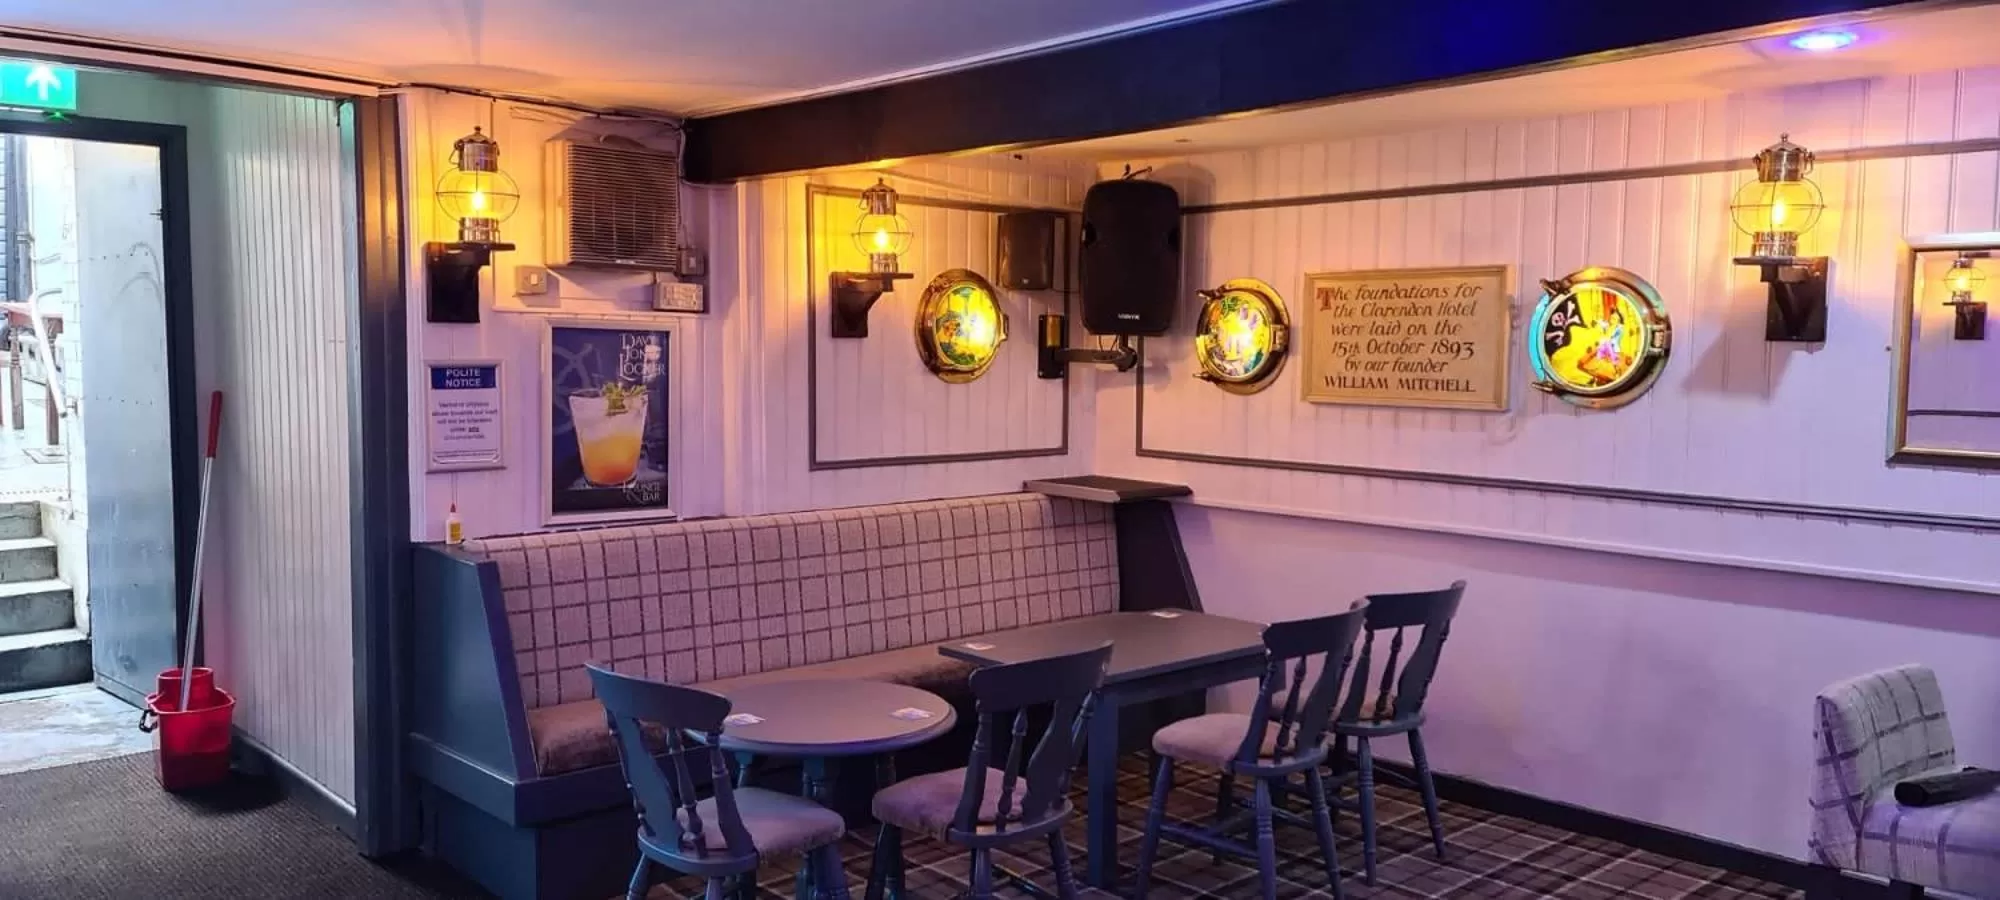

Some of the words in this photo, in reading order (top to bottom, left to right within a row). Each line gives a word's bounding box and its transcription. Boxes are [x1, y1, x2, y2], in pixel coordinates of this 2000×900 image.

[1316, 287, 1350, 311] The
[1354, 283, 1449, 301] foundations
[1453, 282, 1483, 299] for
[1333, 303, 1356, 319] the
[1360, 301, 1434, 318] Clarendon
[1435, 301, 1477, 317] Hotel
[1331, 322, 1366, 336] were
[1368, 321, 1401, 336] laid
[1407, 324, 1428, 336] on
[1435, 319, 1464, 336] the
[624, 344, 662, 362] JON
[1331, 340, 1361, 357] 15th
[1367, 338, 1425, 355] October
[1430, 339, 1476, 361] 1893
[446, 368, 481, 377] POLITE
[1343, 358, 1362, 372] by
[1364, 360, 1390, 372] our
[1391, 358, 1449, 374] founder
[445, 377, 481, 387] NOTICE
[1323, 375, 1390, 391] WILLIAM
[1396, 376, 1477, 393] MITCHELL
